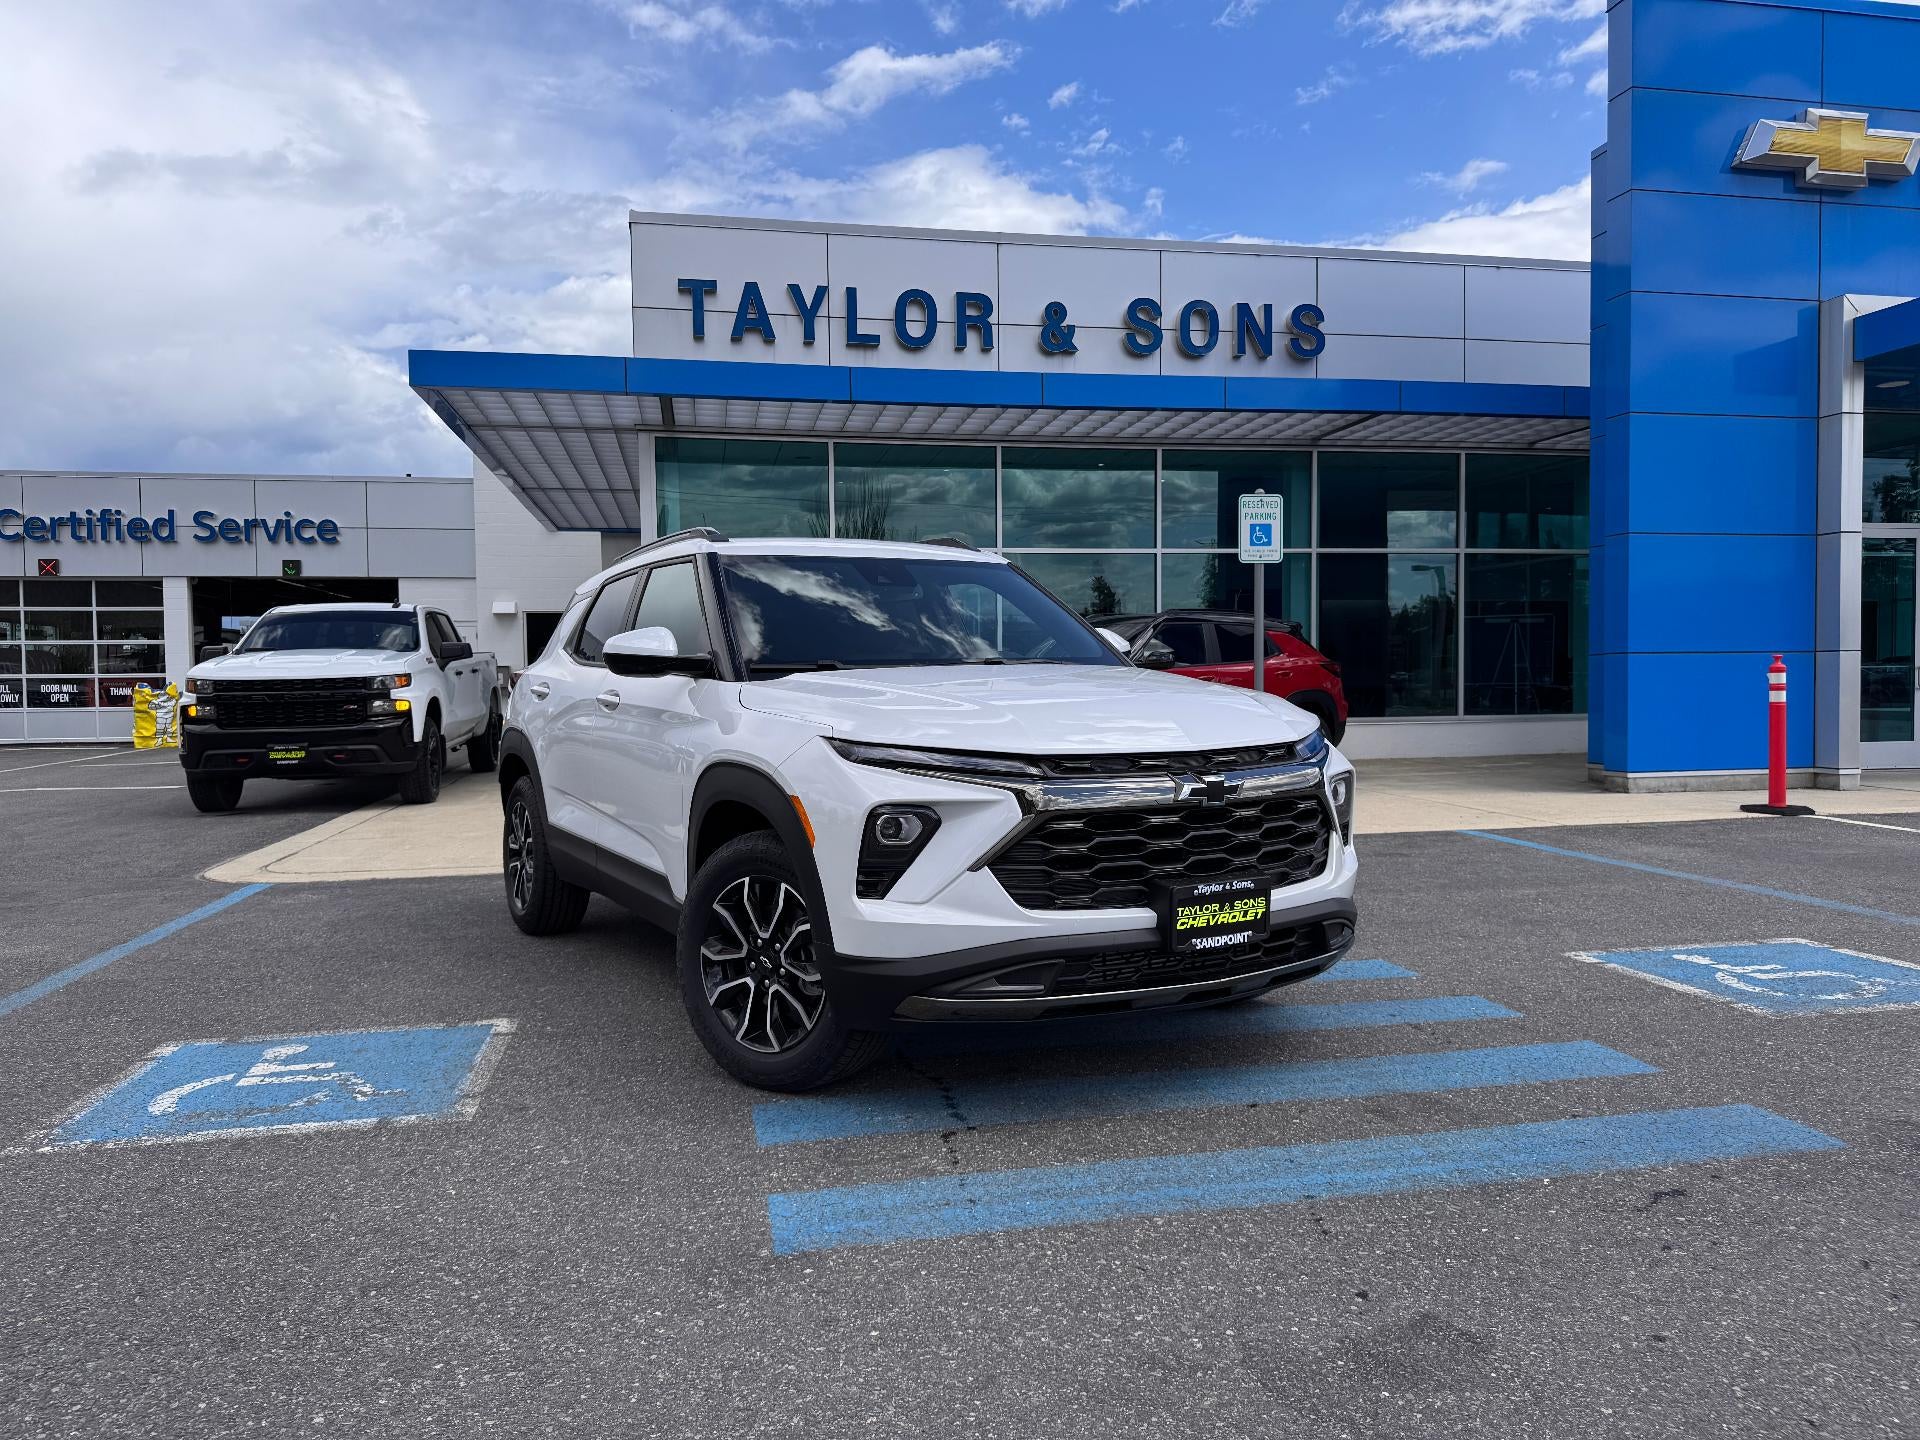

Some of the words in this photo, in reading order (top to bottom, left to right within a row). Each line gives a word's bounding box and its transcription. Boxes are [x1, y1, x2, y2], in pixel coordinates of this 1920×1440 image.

[677, 278, 994, 353] TAYLOR
[1040, 301, 1077, 354] &
[1124, 297, 1326, 360] SONS
[1243, 500, 1279, 509] RESERVED
[1244, 512, 1277, 521] PARKING
[0, 508, 176, 543] Certified
[192, 510, 339, 543] Service
[41, 684, 60, 693] DOOR
[62, 684, 78, 693] WILL
[110, 687, 133, 696] THANK
[51, 693, 69, 703] OPEN
[1198, 884, 1224, 895] Taylor
[1225, 882, 1230, 890] &
[1232, 880, 1251, 890] Sons
[1177, 903, 1220, 917] TAYLOR
[1224, 902, 1230, 912] &
[1234, 897, 1266, 910] SONS
[1176, 908, 1266, 930] CHEVROLET
[1195, 931, 1249, 950] SANDPOINT
